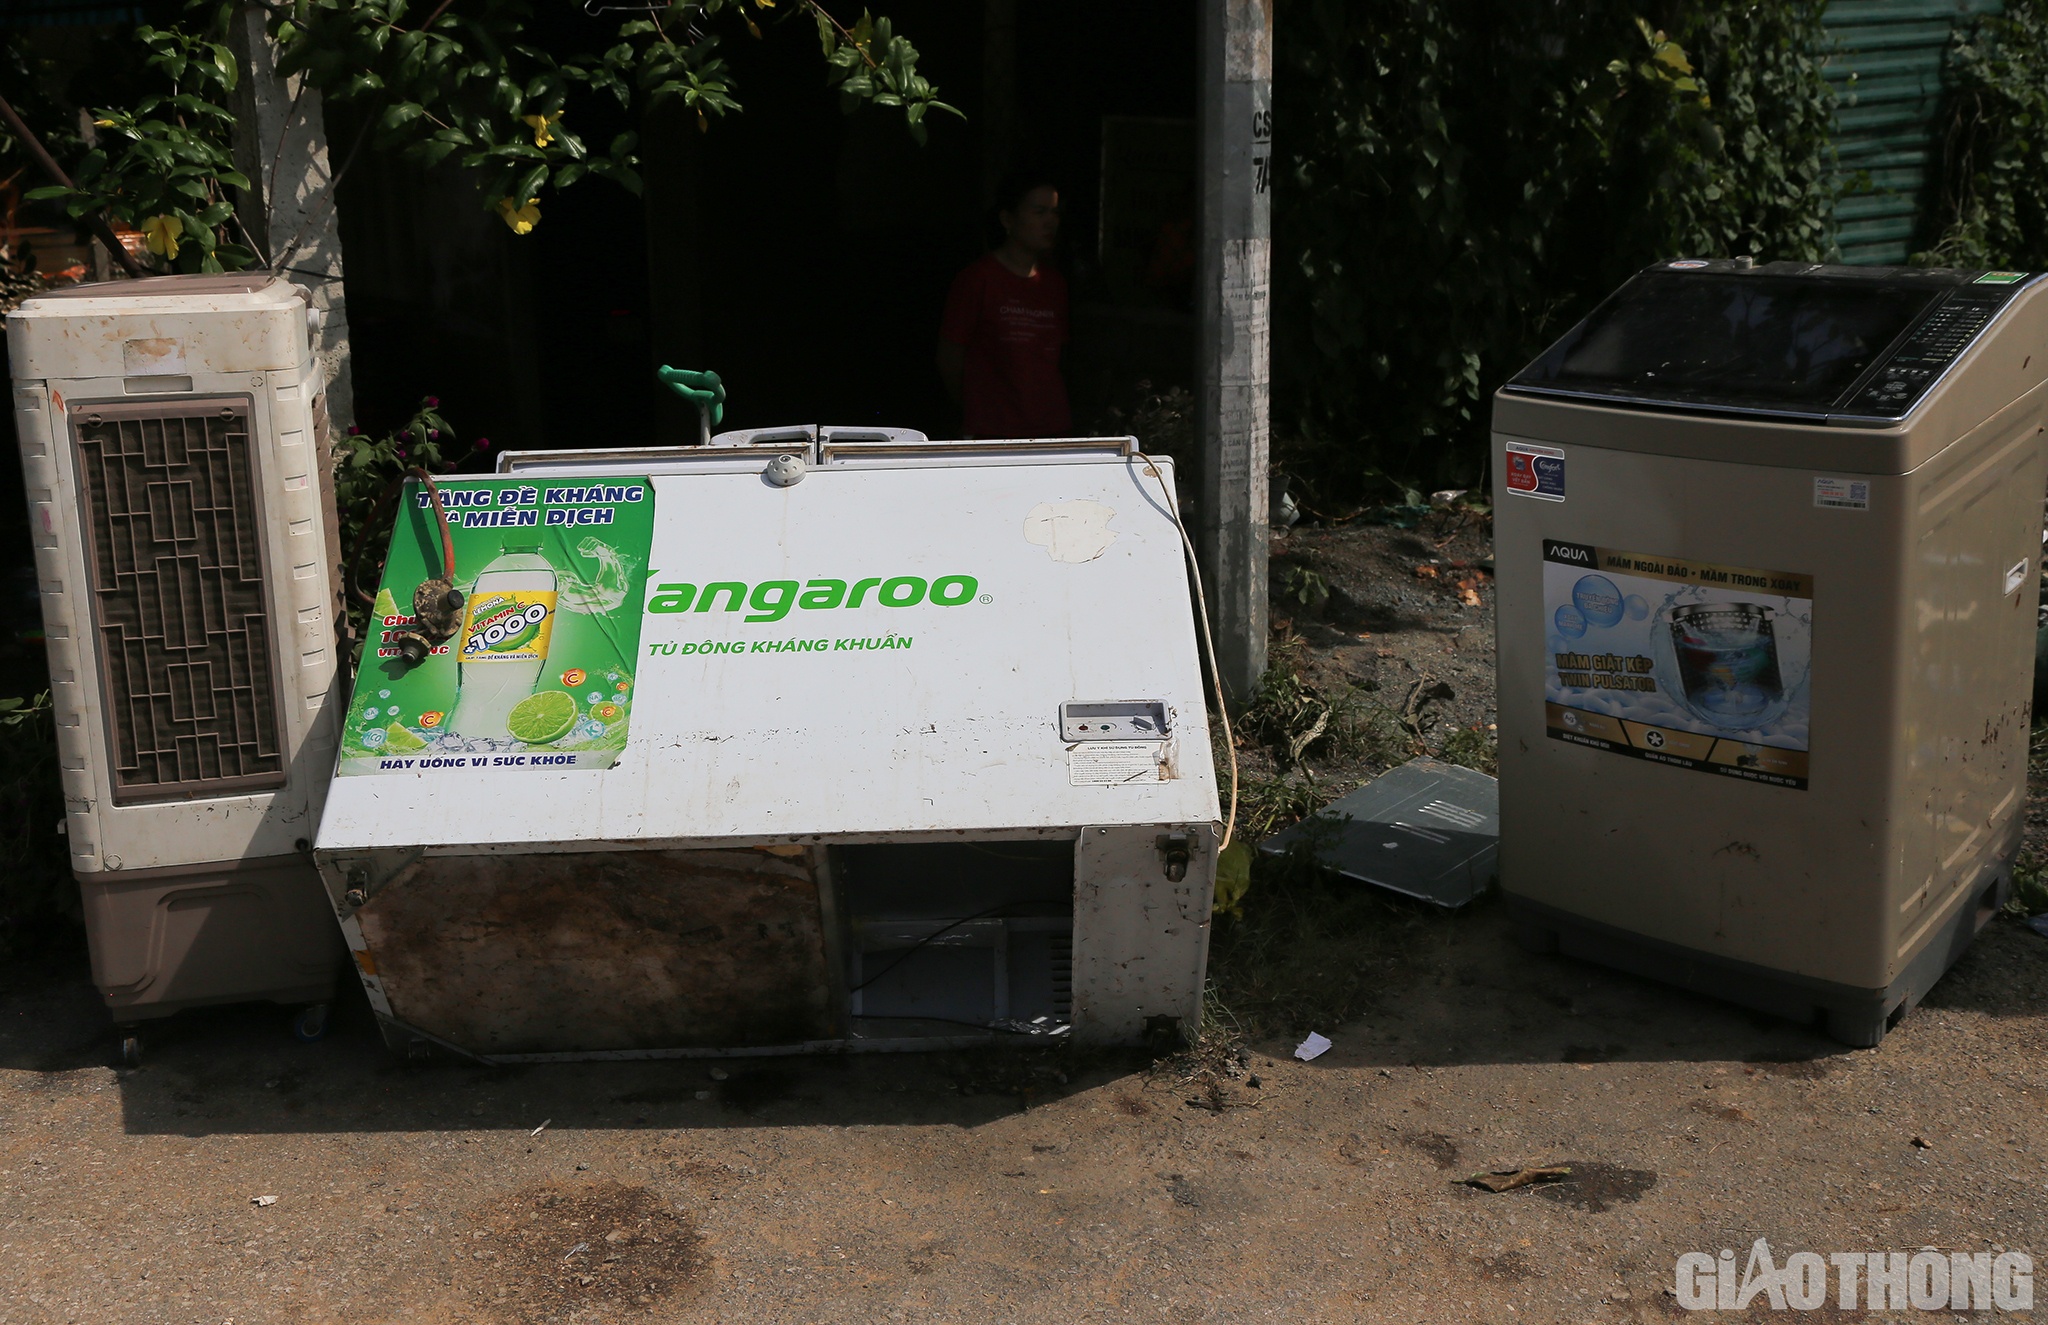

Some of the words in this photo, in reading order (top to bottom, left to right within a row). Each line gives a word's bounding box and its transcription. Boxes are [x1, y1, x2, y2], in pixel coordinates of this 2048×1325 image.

[1253, 111, 1271, 138] CS
[416, 489, 491, 507] TĂNG
[498, 486, 538, 506] ĐỀ
[544, 484, 644, 504] KHÁNG
[463, 506, 539, 528] MIỄN
[545, 508, 614, 528] DỊCH
[1550, 545, 1588, 562] AQUA
[1731, 573, 1767, 588] TRONG
[1770, 579, 1801, 591] XOAY
[647, 569, 979, 623] angaroo
[468, 607, 515, 633] VITAMIN
[517, 601, 526, 610] C
[649, 641, 677, 656] TỦ
[681, 639, 746, 655] ĐÔNG
[750, 636, 829, 653] KHÁNG
[834, 633, 914, 652] KHUẨN
[1555, 652, 1590, 670] MÂM
[1592, 653, 1623, 674] GIẶT
[1625, 655, 1653, 674] KÉP
[1558, 672, 1590, 688] TWIN
[1592, 674, 1656, 692] PULSATOR
